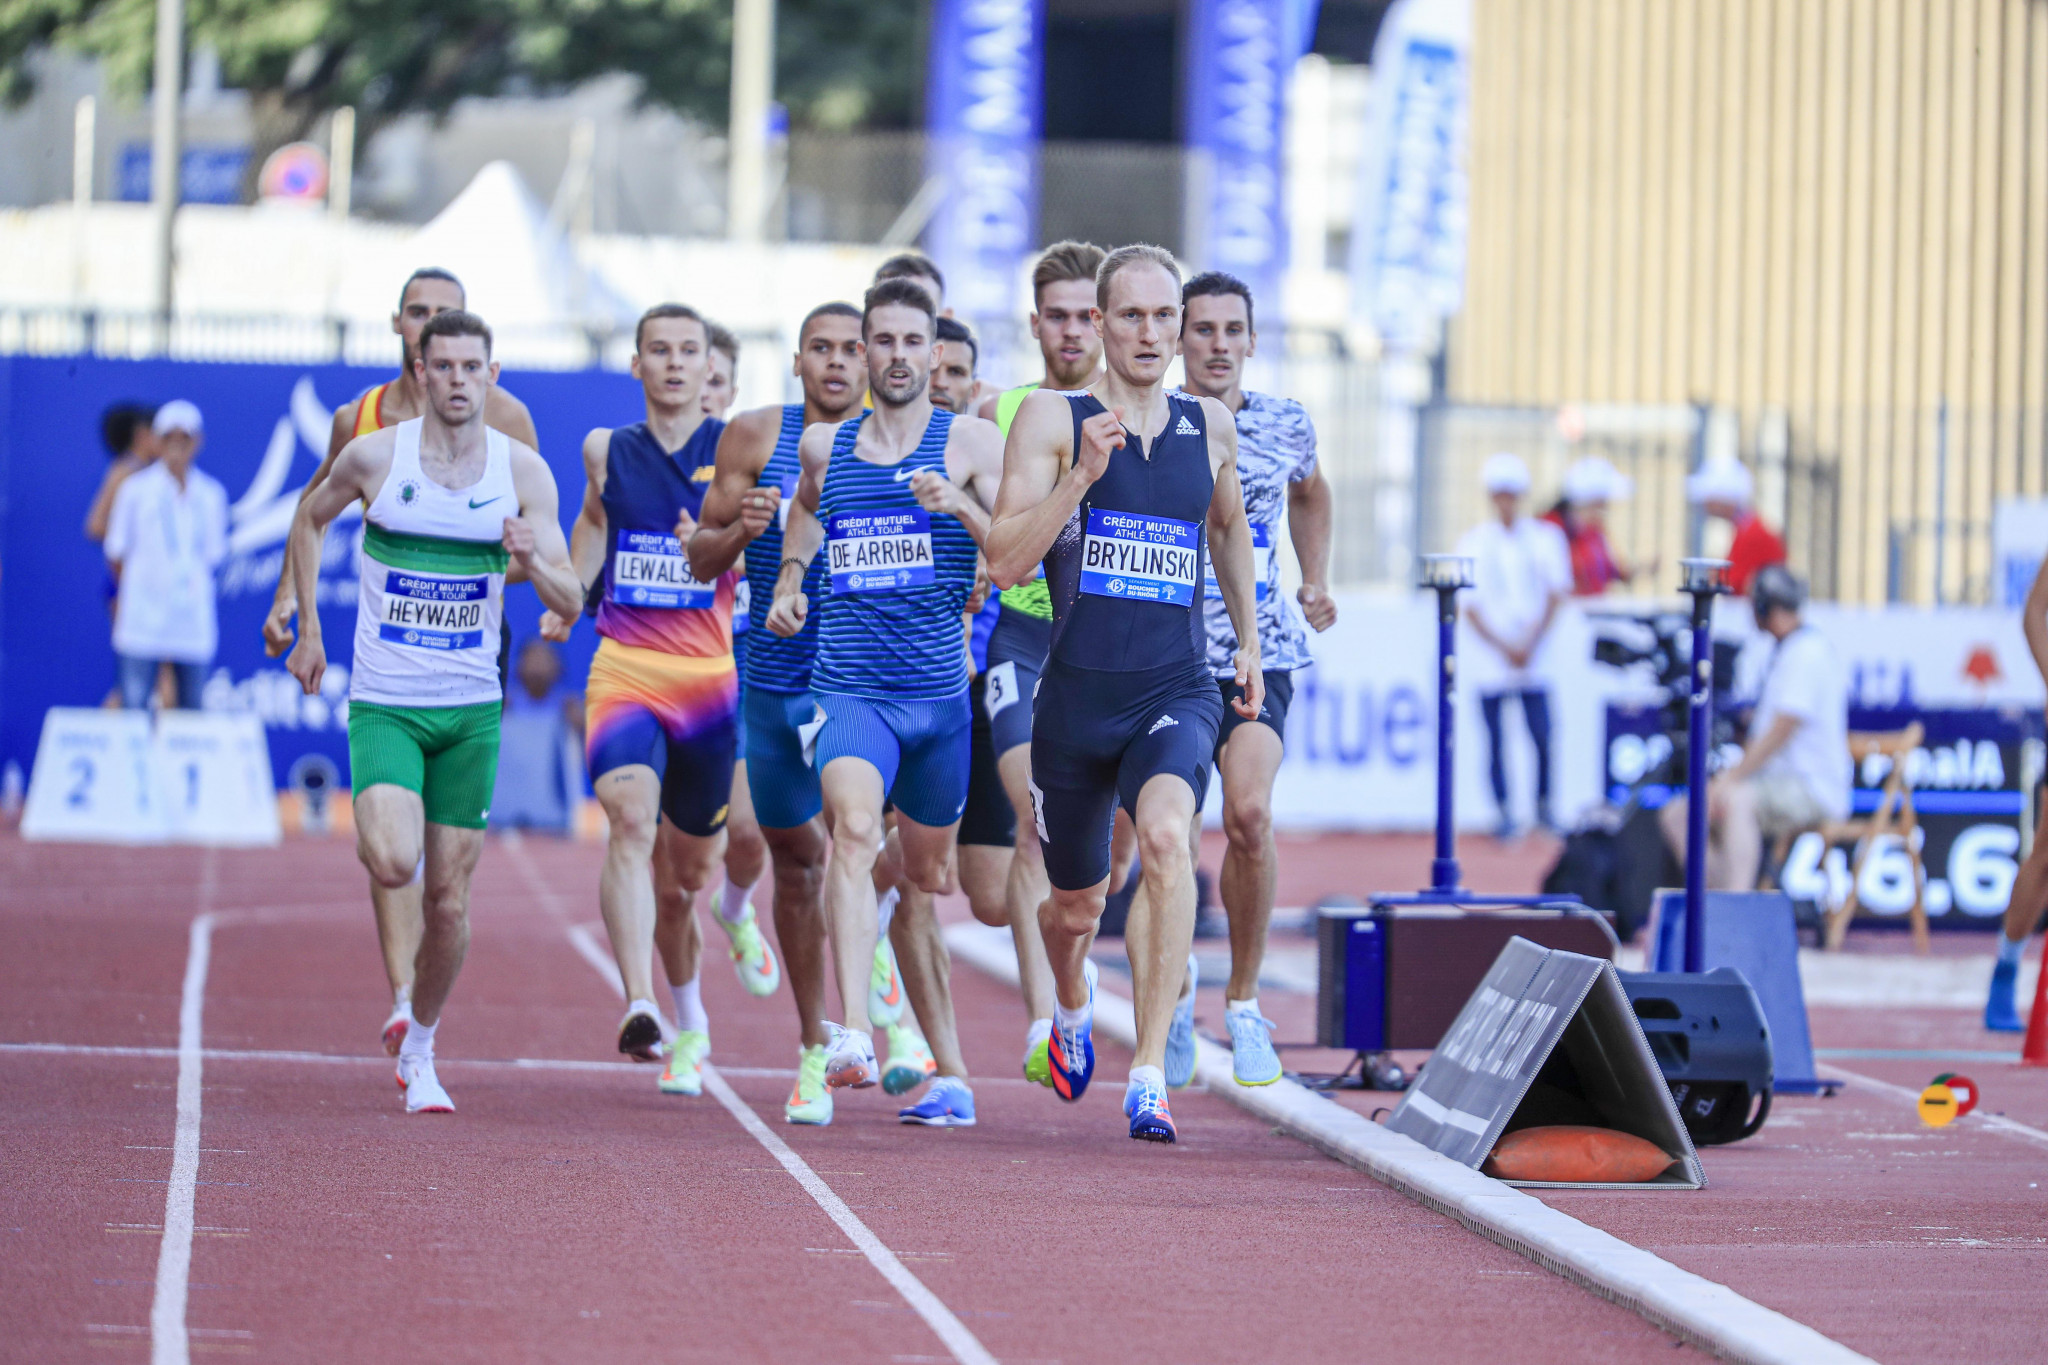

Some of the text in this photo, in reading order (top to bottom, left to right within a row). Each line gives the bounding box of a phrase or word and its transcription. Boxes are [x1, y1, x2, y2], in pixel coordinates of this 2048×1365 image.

[1176, 427, 1200, 435] adidas
[837, 514, 917, 529] CRÉDIT MUTUEL
[846, 525, 904, 537] ATHLÉ TOUR
[1103, 515, 1188, 537] CRÉDIT MUTUEL
[630, 533, 664, 546] CRÉDIT
[1114, 528, 1176, 545] ATHLÉ TOUR
[832, 538, 929, 569] DE ARRIBA
[1086, 540, 1194, 580] BRYLINSKI
[621, 556, 711, 585] LEWALS
[399, 577, 479, 593] CRÉDIT MUTUEL
[409, 588, 467, 601] ATHLÉ TOUR
[389, 599, 480, 628] HEYWARD
[992, 674, 1004, 704] 3
[67, 755, 96, 813] 2
